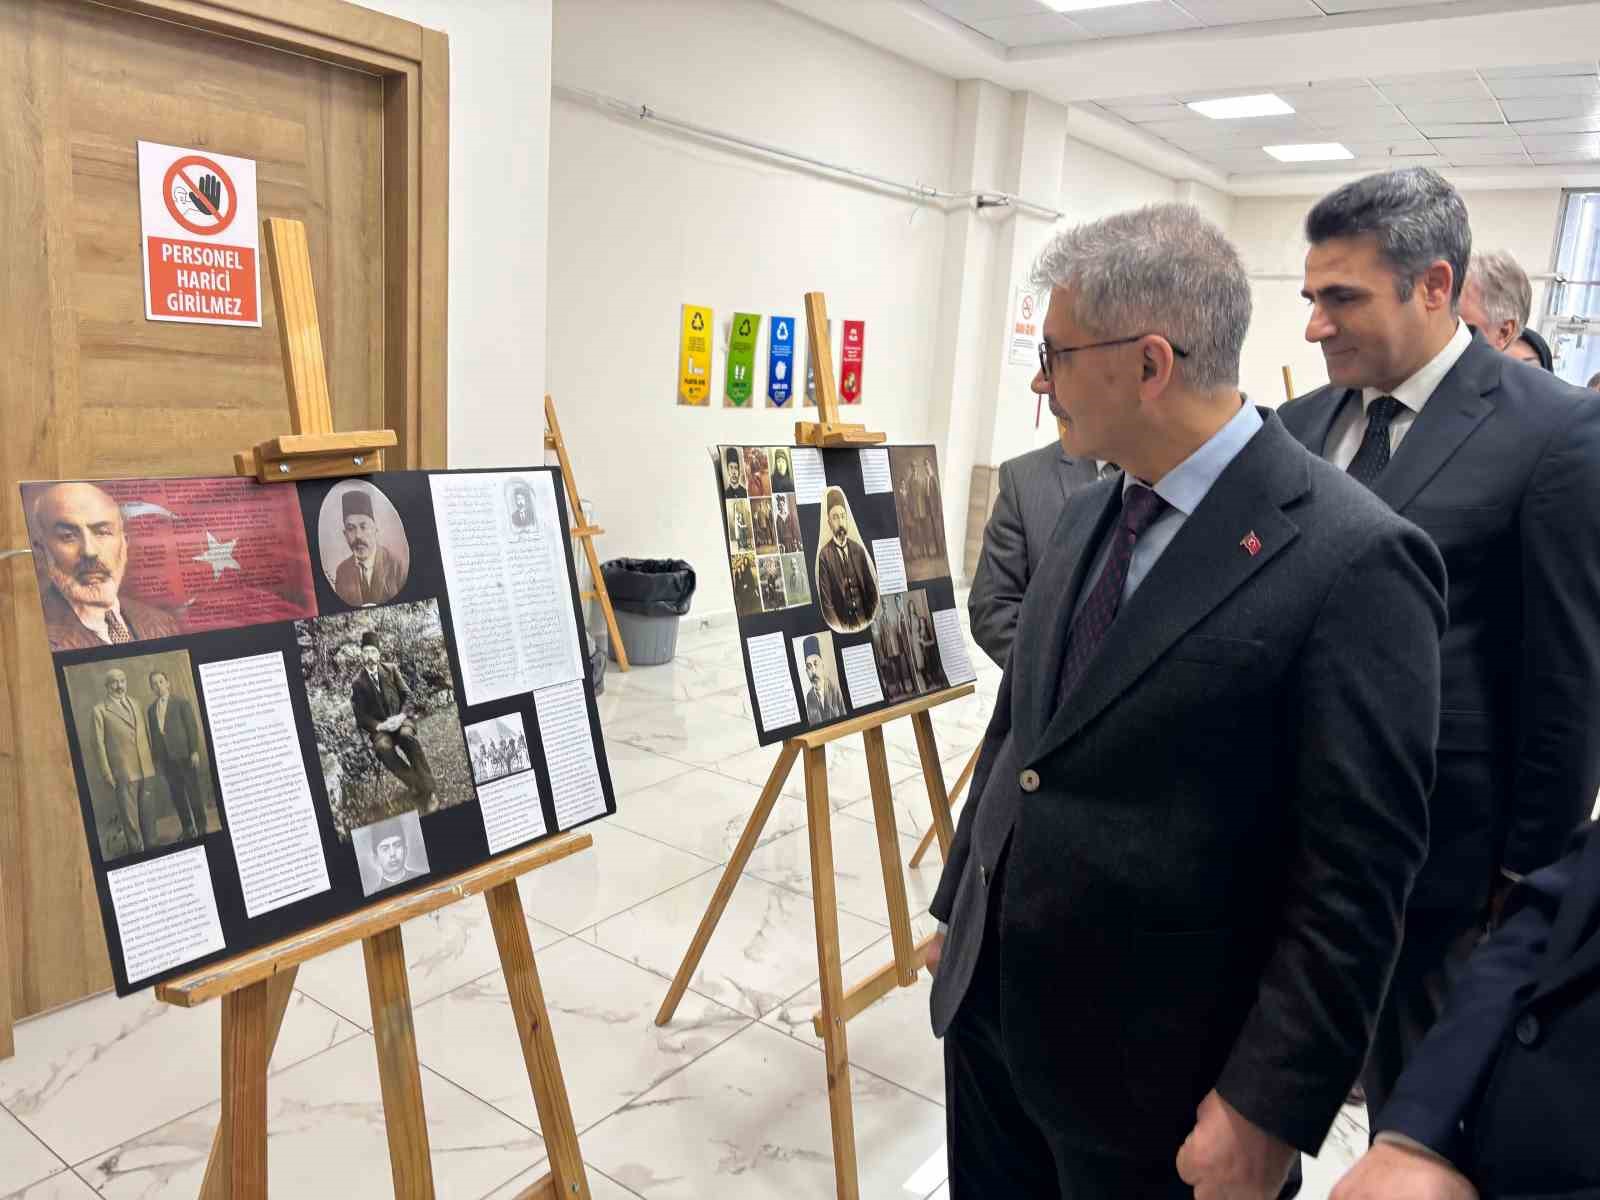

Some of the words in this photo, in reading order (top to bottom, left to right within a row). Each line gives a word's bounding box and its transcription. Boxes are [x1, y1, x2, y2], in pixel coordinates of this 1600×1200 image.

[161, 243, 243, 269] PERSONEL
[176, 269, 231, 292] HARİCİ
[167, 291, 242, 316] GİRİLMEZ
